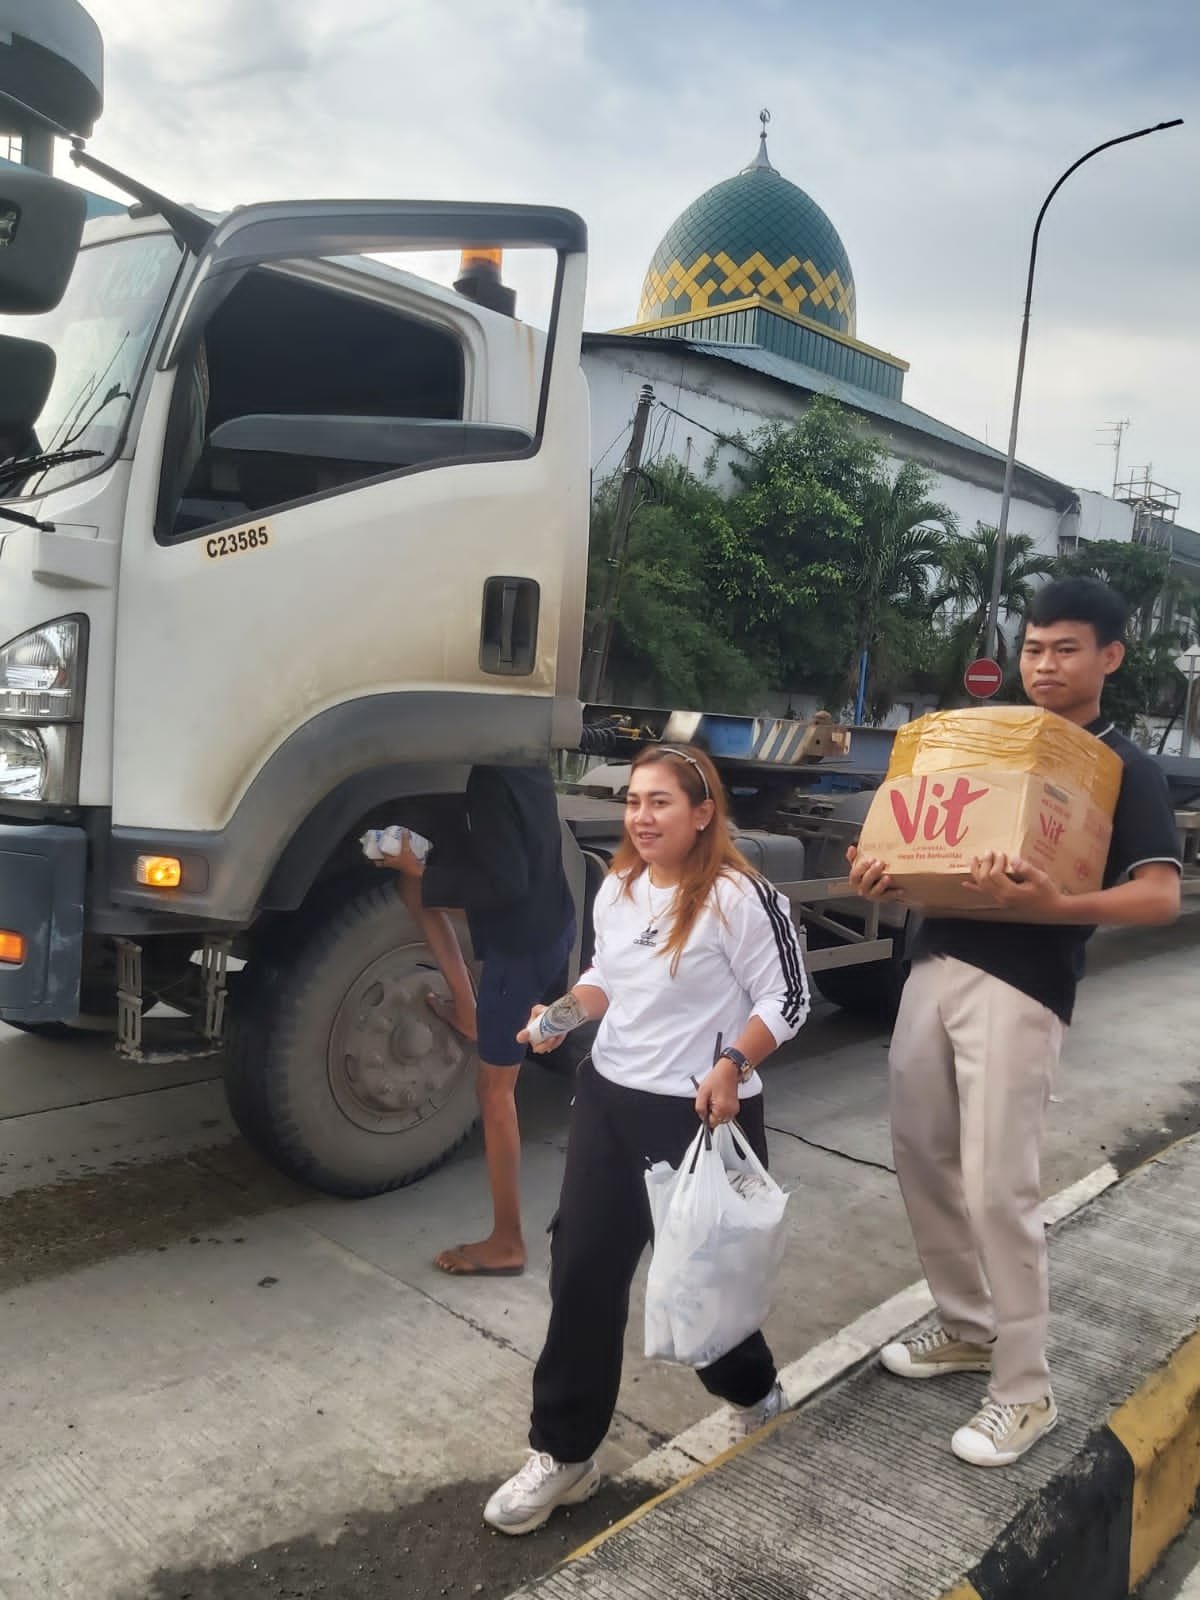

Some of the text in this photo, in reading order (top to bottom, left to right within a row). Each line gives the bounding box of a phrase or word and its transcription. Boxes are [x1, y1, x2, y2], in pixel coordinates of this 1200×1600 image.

[206, 525, 269, 558] C23585
[890, 775, 989, 847] Vit
[1039, 812, 1066, 846] Vit
